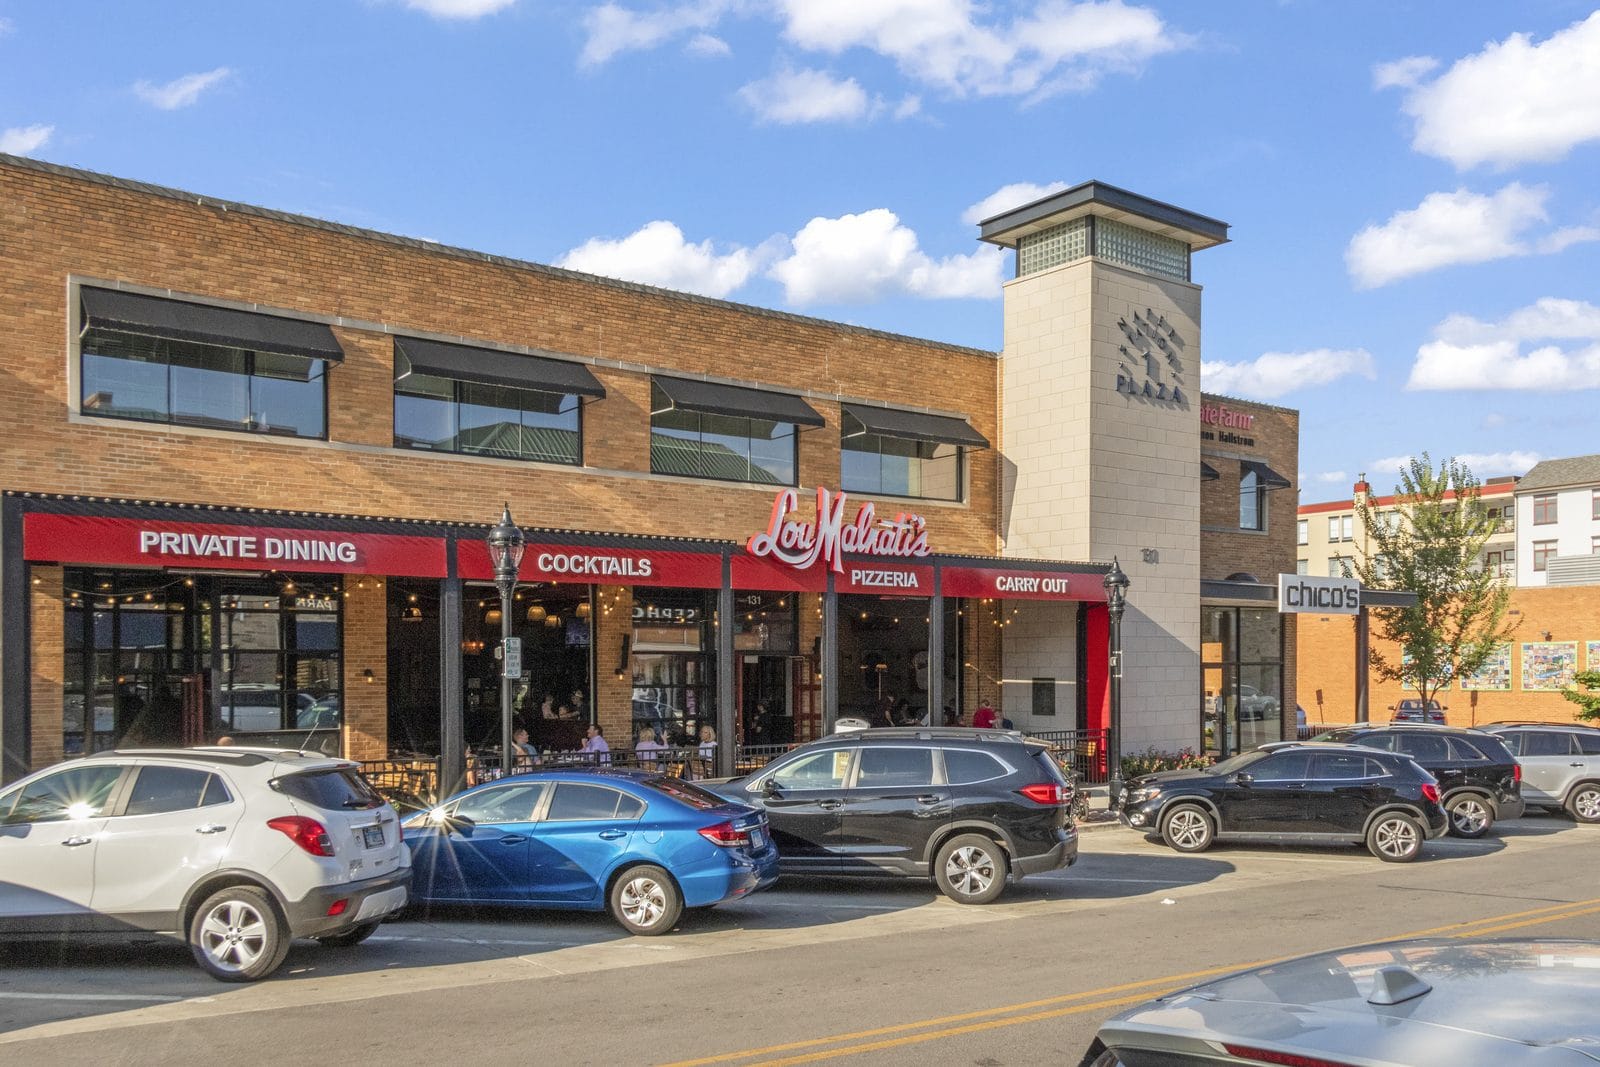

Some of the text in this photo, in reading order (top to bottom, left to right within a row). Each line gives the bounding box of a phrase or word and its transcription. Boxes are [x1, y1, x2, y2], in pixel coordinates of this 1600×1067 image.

[1116, 374, 1181, 403] PLAZA
[748, 487, 934, 574] Lou Malnati's
[140, 531, 357, 562] PRIVATE DINING
[538, 553, 652, 577] COCKTAILS
[851, 569, 919, 588] PIZZERIA
[996, 576, 1068, 594] CARRY OUT
[746, 595, 761, 605] 131
